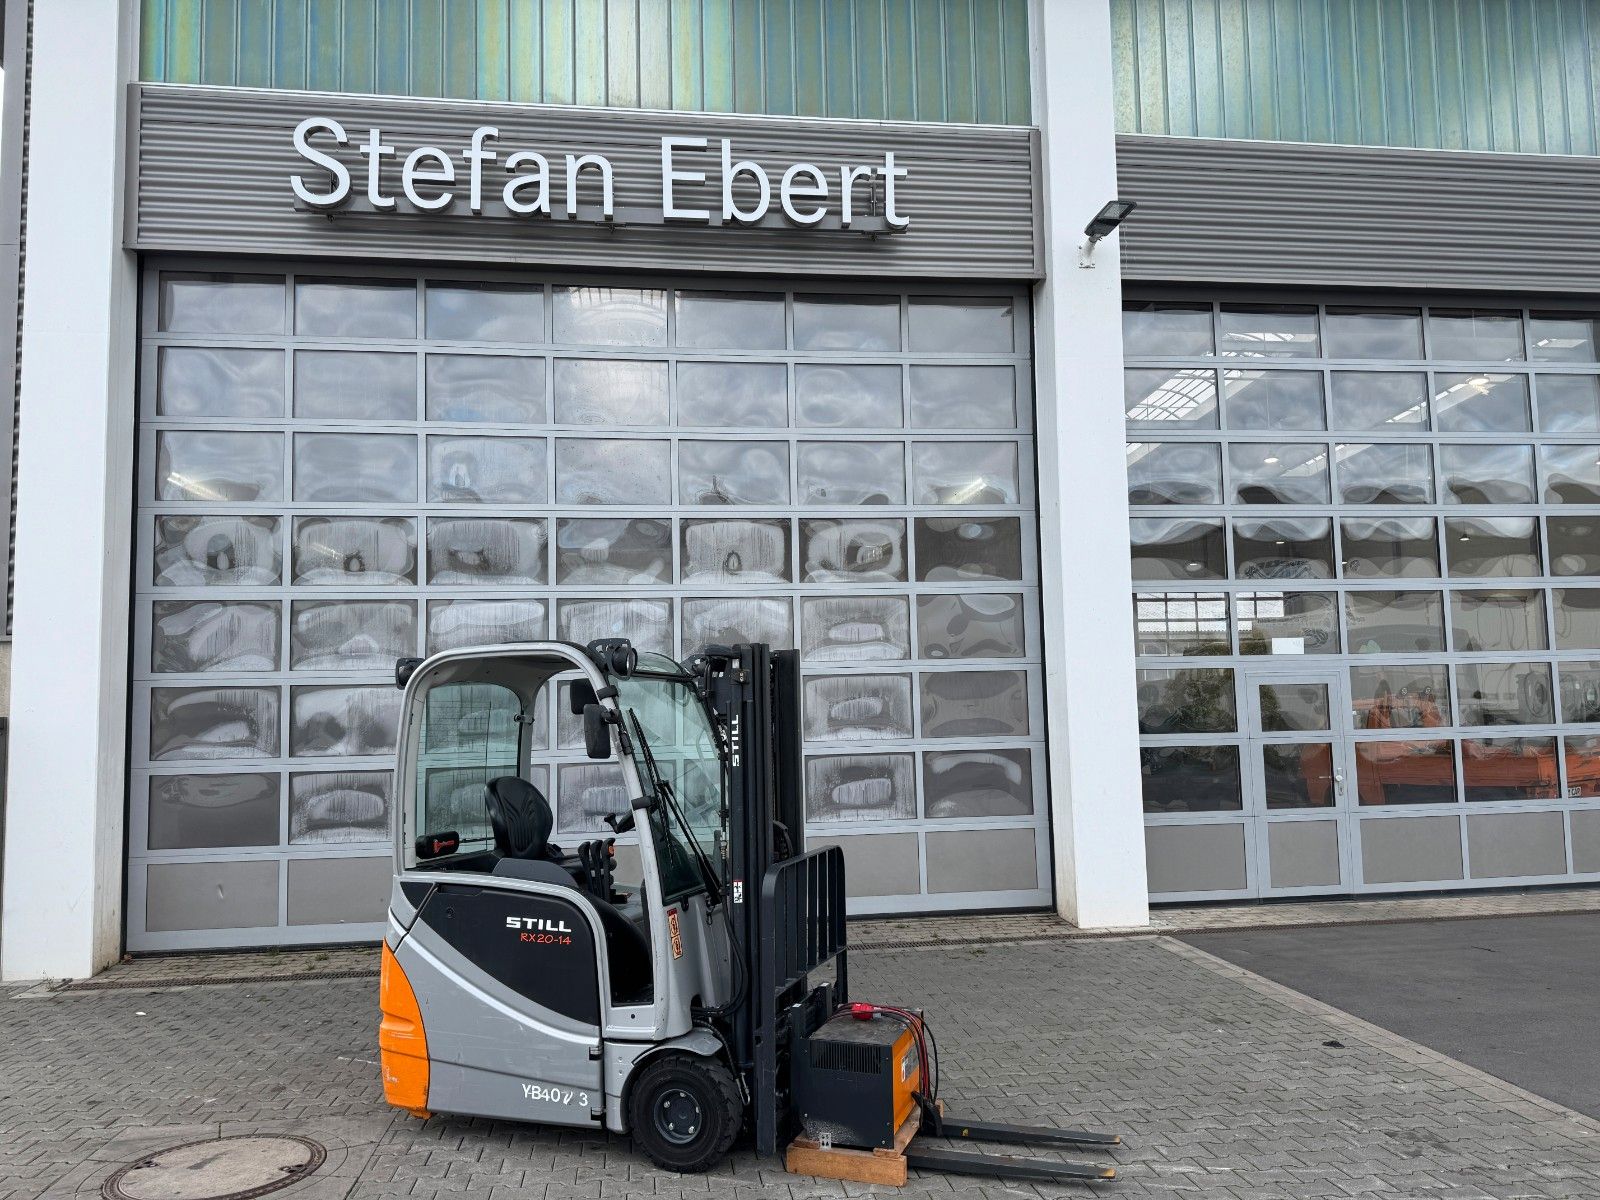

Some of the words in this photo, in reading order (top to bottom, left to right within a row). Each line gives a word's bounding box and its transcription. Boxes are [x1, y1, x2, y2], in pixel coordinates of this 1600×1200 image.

[290, 117, 613, 221] Stefan
[661, 136, 910, 227] Ebert
[731, 714, 740, 767] STILL
[506, 916, 572, 933] STILL
[520, 932, 572, 945] RX20-14
